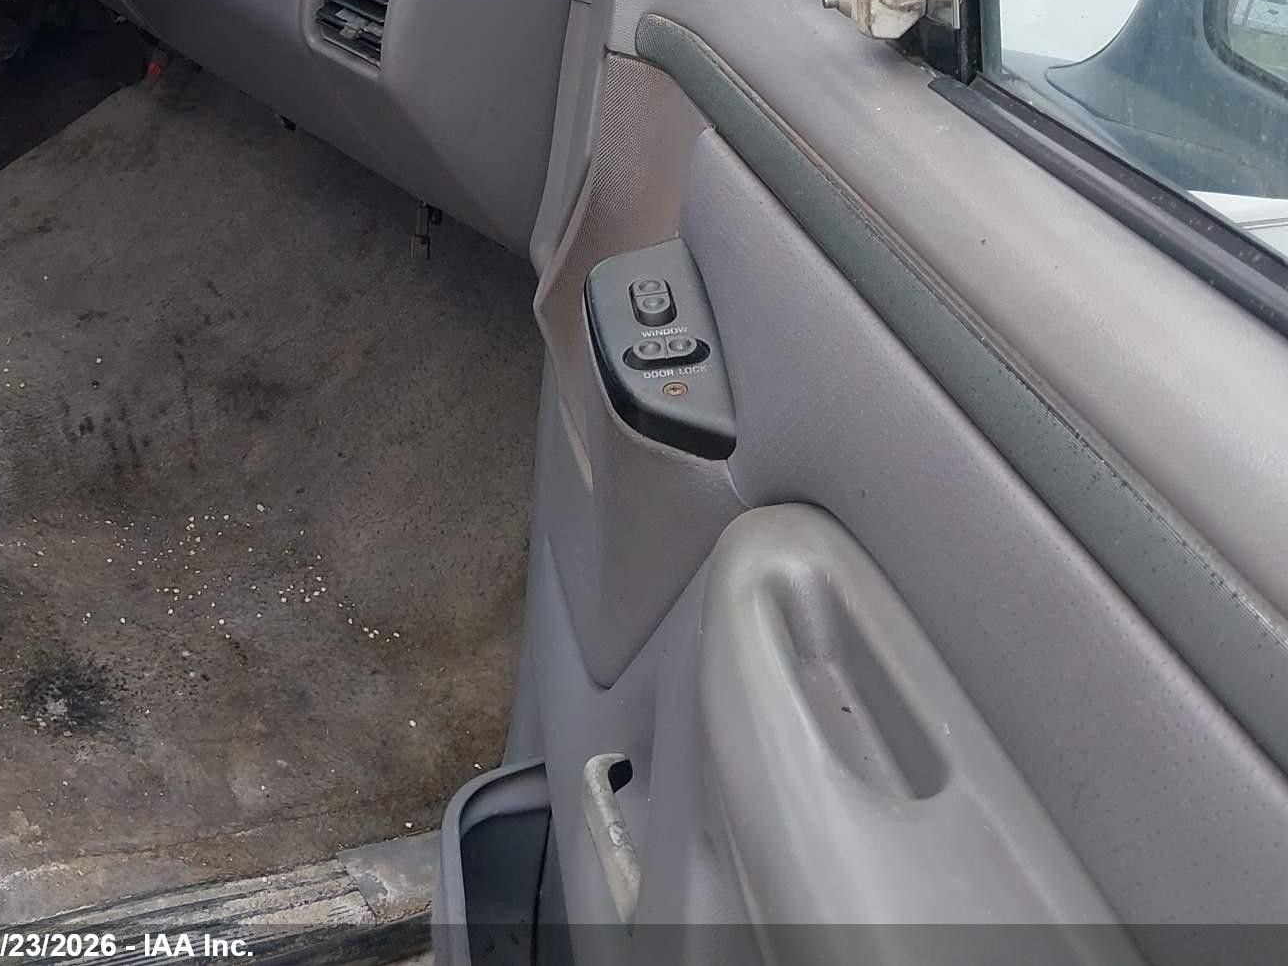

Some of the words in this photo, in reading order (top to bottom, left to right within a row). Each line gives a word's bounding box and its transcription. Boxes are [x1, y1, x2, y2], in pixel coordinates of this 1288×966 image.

[641, 326, 688, 338] WINDOW
[643, 369, 674, 379] DOOR
[678, 365, 708, 375] LOCK
